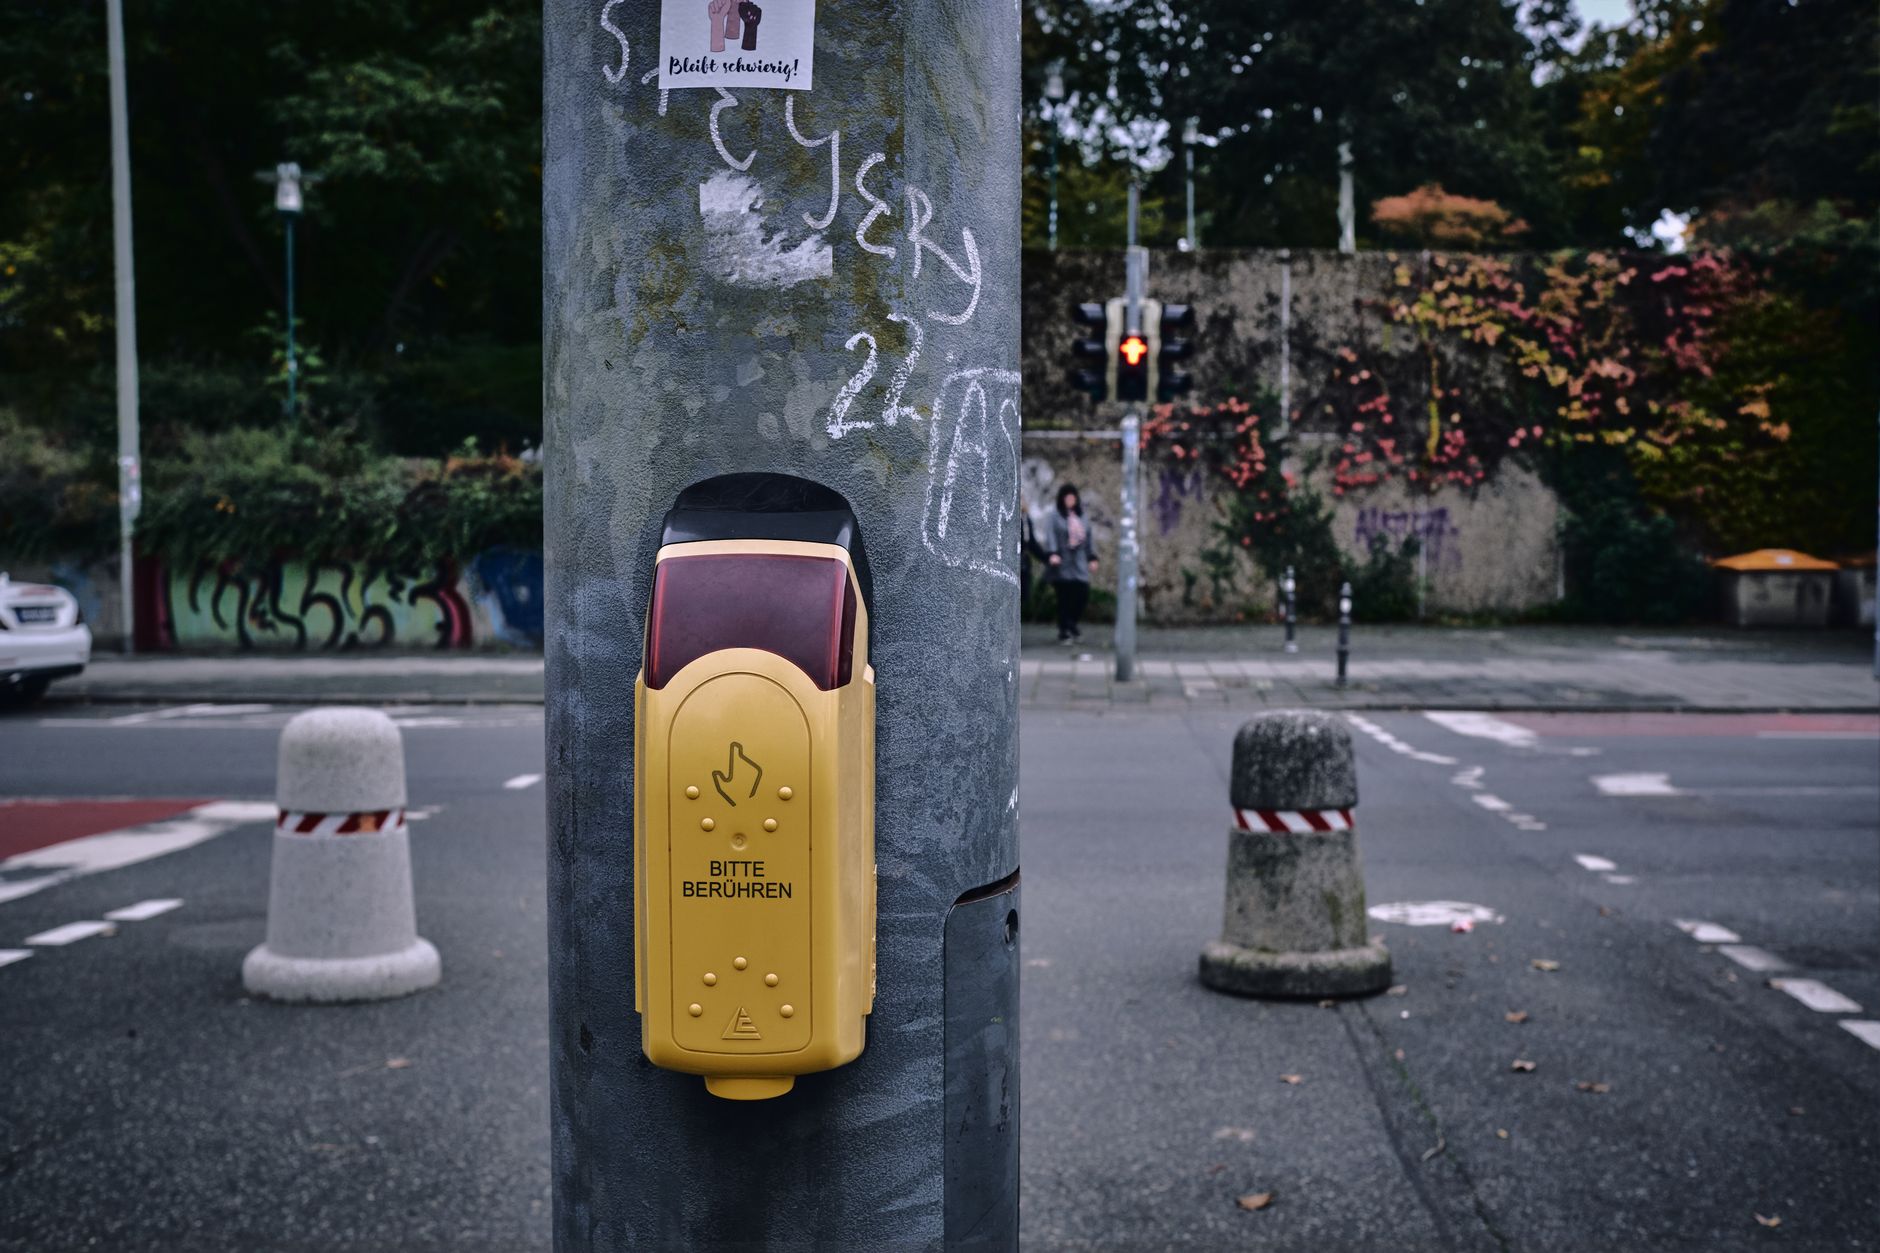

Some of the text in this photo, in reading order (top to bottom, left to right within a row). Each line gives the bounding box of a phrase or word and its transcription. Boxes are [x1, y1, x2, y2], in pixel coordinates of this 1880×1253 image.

[669, 56, 799, 82] Bleibt schwierig!
[710, 860, 765, 877] BITTE
[682, 879, 792, 898] BERÜHREN
